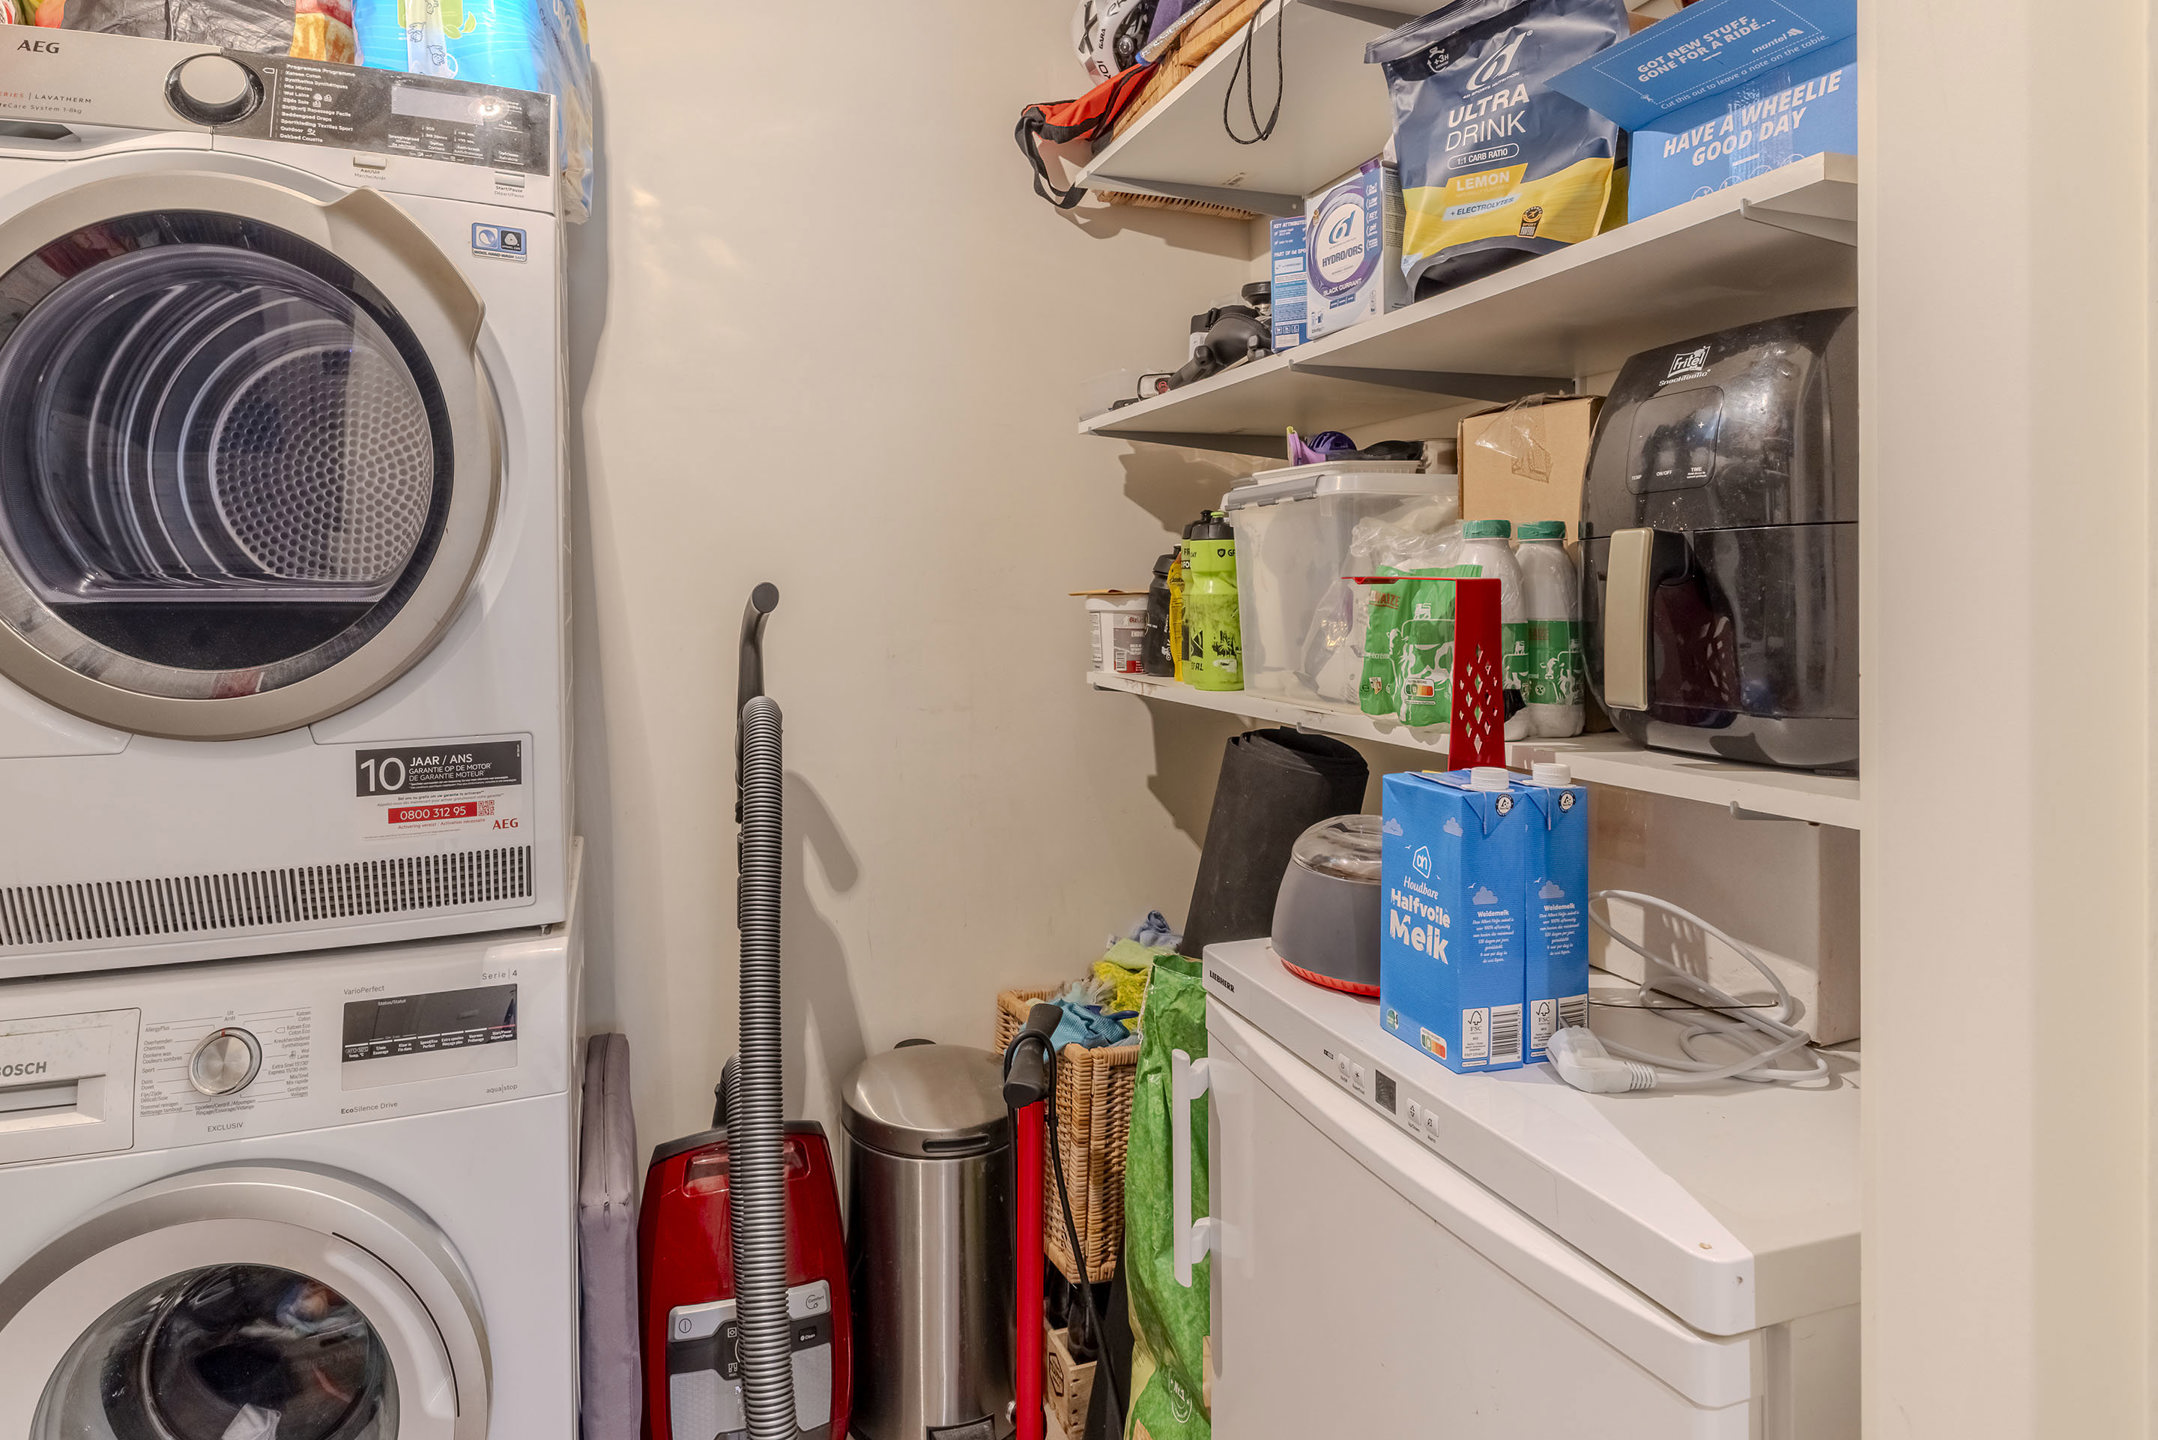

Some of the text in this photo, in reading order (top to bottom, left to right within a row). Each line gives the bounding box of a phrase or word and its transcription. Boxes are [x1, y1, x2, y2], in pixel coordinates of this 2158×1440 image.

[17, 40, 60, 54] AEG
[1638, 19, 1776, 82] GONE FOR A RIDE...
[1752, 33, 1788, 54] mantel
[1638, 56, 1665, 73] GOT
[1667, 39, 1701, 60] NEW
[1661, 101, 1675, 110] Cut
[1677, 94, 1691, 104] this
[1692, 87, 1707, 97] out
[1707, 83, 1716, 91] to
[1717, 73, 1740, 86] leave
[1749, 60, 1770, 72] note
[1771, 54, 1784, 62] on
[1784, 46, 1801, 56] the
[30, 105, 60, 113] System
[35, 94, 92, 104] LAVATHERM
[1449, 83, 1530, 128] ULTRA
[1663, 70, 1843, 159] HAVE A WHEELIE
[1445, 110, 1526, 152] DRINK
[1692, 107, 1807, 167] GOOD DAY
[1457, 148, 1508, 165] 1:1 CARB RATIO
[1457, 171, 1510, 192] LEMON
[1457, 197, 1515, 216] ELECTROLYTES
[1322, 244, 1363, 268] HYDRO/ORS
[1323, 278, 1362, 297] BLACK CURRANT
[409, 766, 444, 775] GARANTIE
[445, 765, 455, 773] OP
[456, 764, 465, 772] DE
[410, 754, 473, 767] JAAR / ANS
[361, 757, 406, 793] 10
[420, 773, 454, 781] GARANTIE
[400, 806, 467, 821] 0800 312 95
[493, 818, 519, 830] AEG
[1404, 875, 1439, 900] Houdbare
[1391, 888, 1451, 928] Halfvolle
[1477, 910, 1510, 918] Weidemelk
[1390, 909, 1449, 965] Melk
[344, 985, 385, 996] VarioPerfect
[482, 971, 507, 981] Serie
[1210, 970, 1235, 993] LIEBHERR
[0, 1061, 47, 1077] OSCH
[341, 1101, 398, 1114] EcoSilence Drive
[207, 1122, 244, 1133] EXCLUSIV
